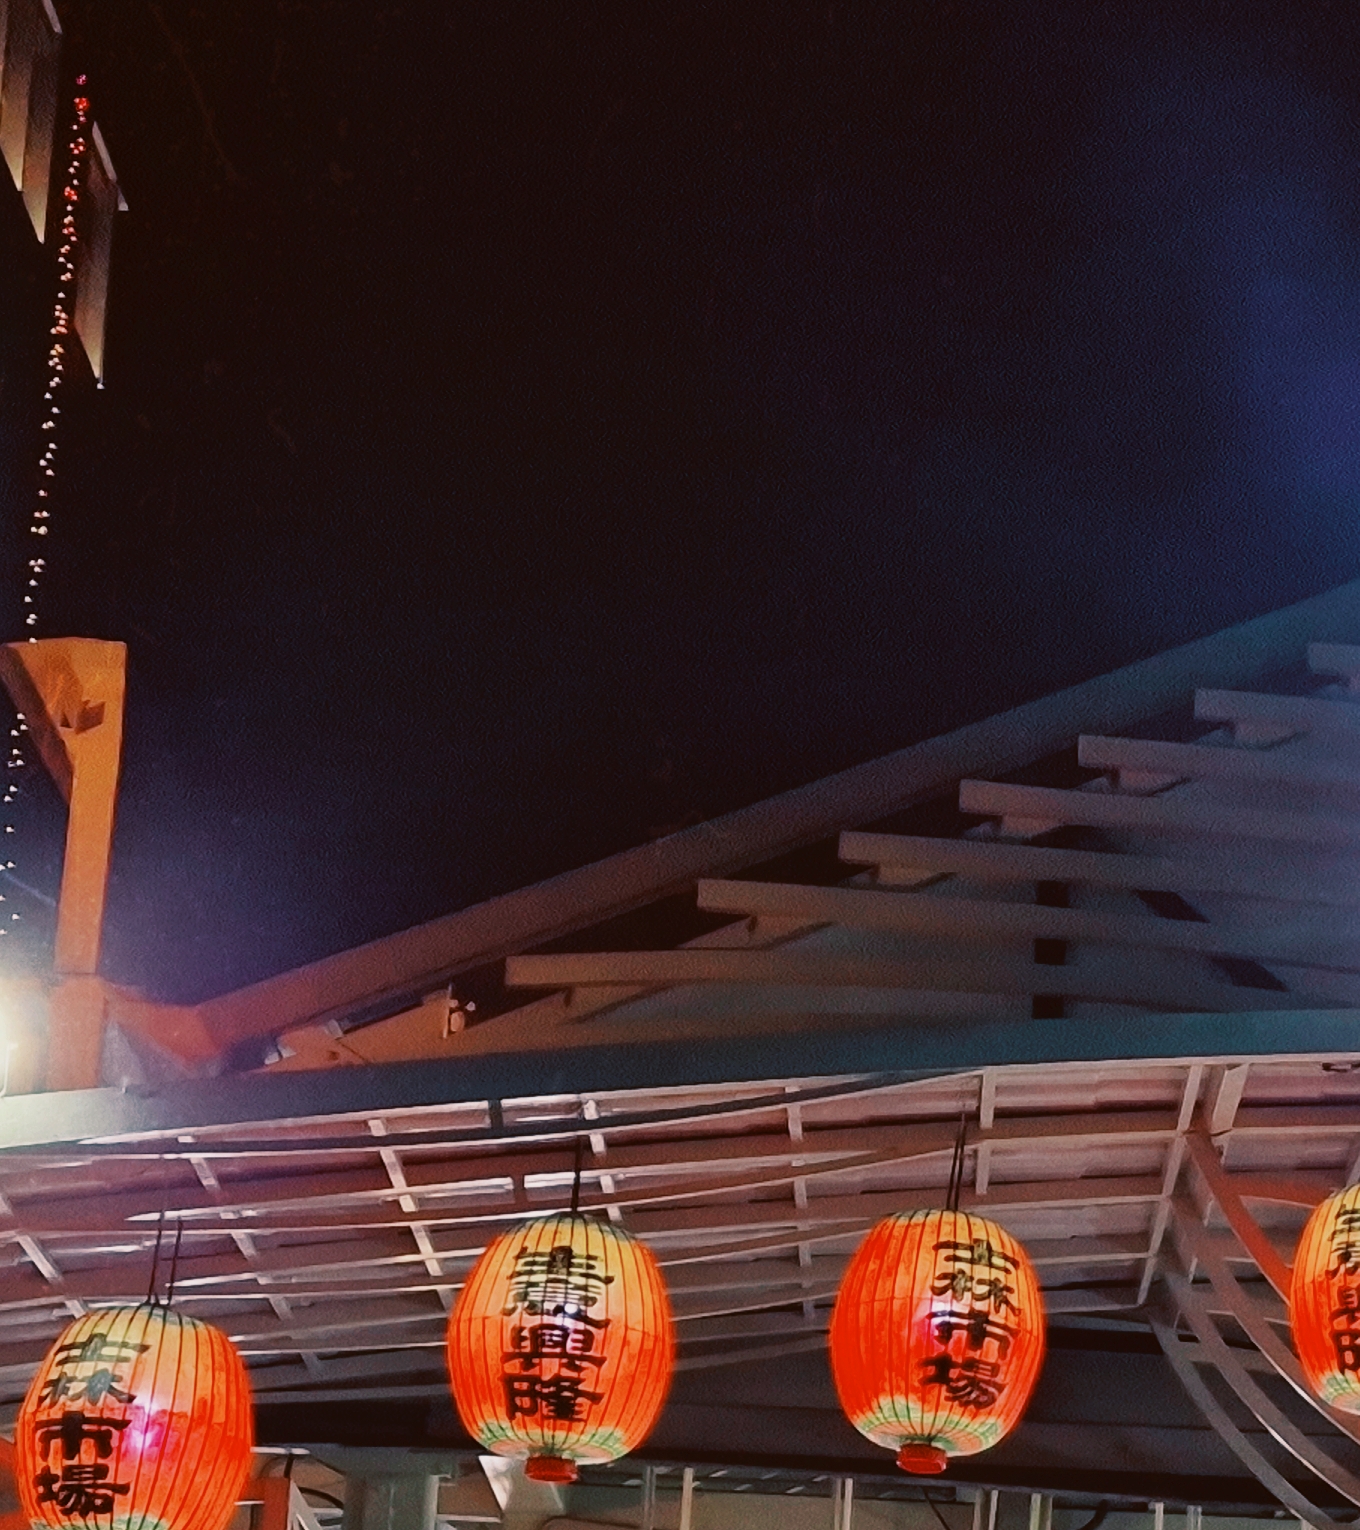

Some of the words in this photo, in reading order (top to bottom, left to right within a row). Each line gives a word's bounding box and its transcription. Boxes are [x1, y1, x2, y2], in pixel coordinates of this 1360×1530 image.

[498, 1246, 615, 1423] 生意興隆
[917, 1236, 1021, 1410] 士林市場
[33, 1332, 152, 1517] 士林市場
